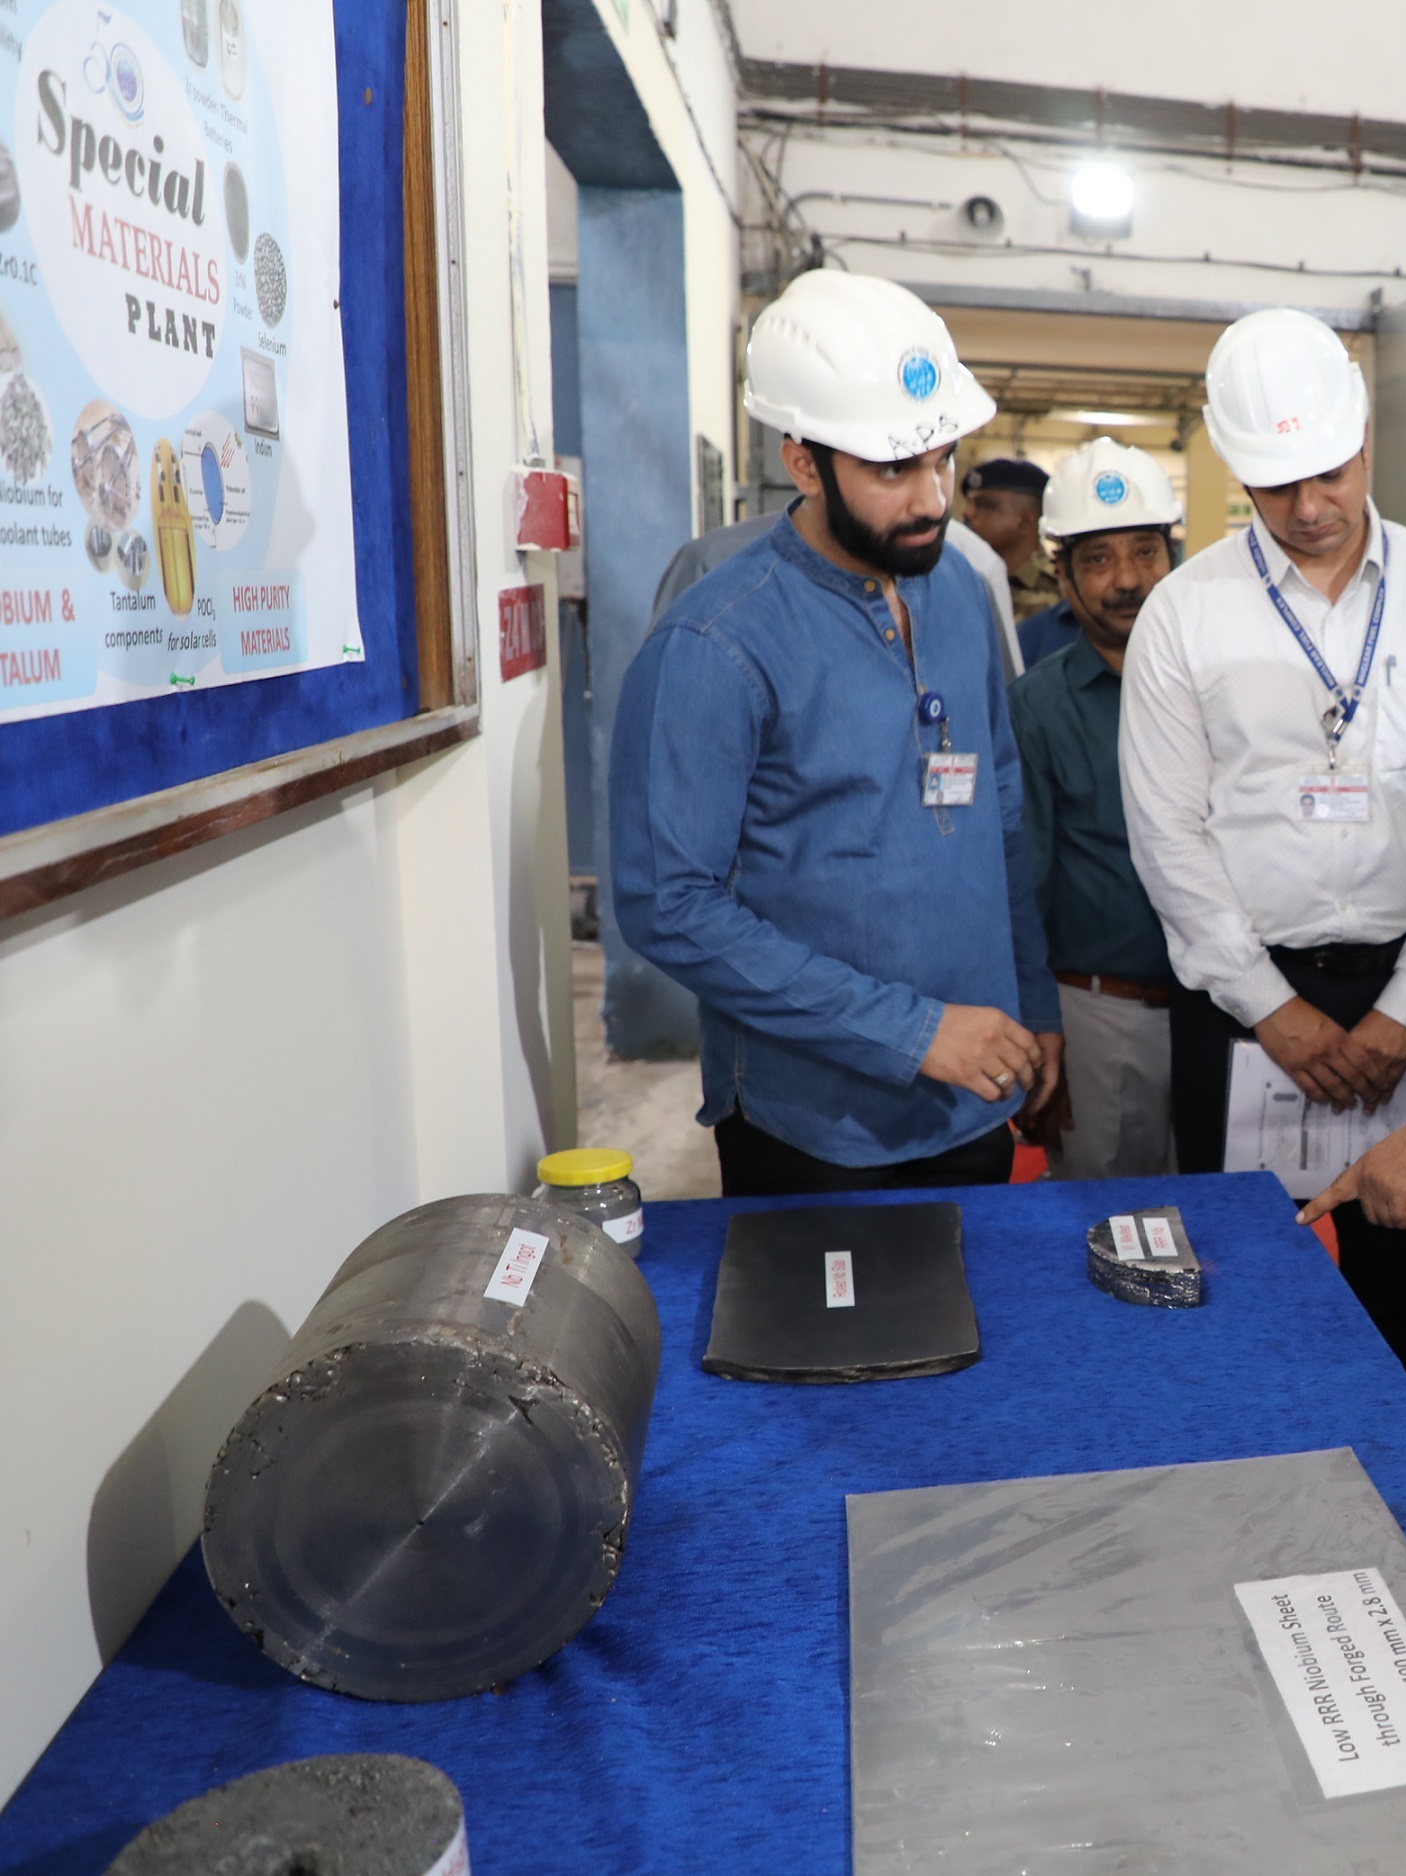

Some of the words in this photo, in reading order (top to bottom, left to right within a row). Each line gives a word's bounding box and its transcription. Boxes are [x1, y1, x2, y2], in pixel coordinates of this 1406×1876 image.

[37, 69, 206, 227] Special
[69, 194, 220, 305] MATERIALS
[125, 292, 216, 359] PLANT
[258, 331, 287, 357] Selenium
[254, 438, 273, 459] Indium
[47, 484, 63, 508] for
[0, 521, 39, 546] oolant
[41, 523, 72, 547] tubes
[0, 589, 52, 625] BIUM
[61, 587, 76, 623] &
[110, 589, 157, 612] Tantalum
[232, 586, 259, 613] HIGH
[260, 585, 290, 611] PURITY
[104, 627, 163, 652] components
[167, 632, 180, 651] for
[180, 630, 201, 650] solar
[201, 631, 217, 648] cells
[240, 626, 291, 657] MATERIALS
[0, 647, 61, 688] TALUM
[1352, 1571, 1377, 1596] mm
[1271, 1593, 1302, 1630] Sheet
[1317, 1595, 1347, 1633] Route
[1361, 1596, 1388, 1618] 2.8
[1377, 1617, 1393, 1628] x
[1291, 1632, 1329, 1692] Niobium
[1330, 1635, 1371, 1683] Forged
[1313, 1693, 1345, 1726] RRR
[1356, 1685, 1401, 1748] through
[1332, 1728, 1360, 1763] Low
